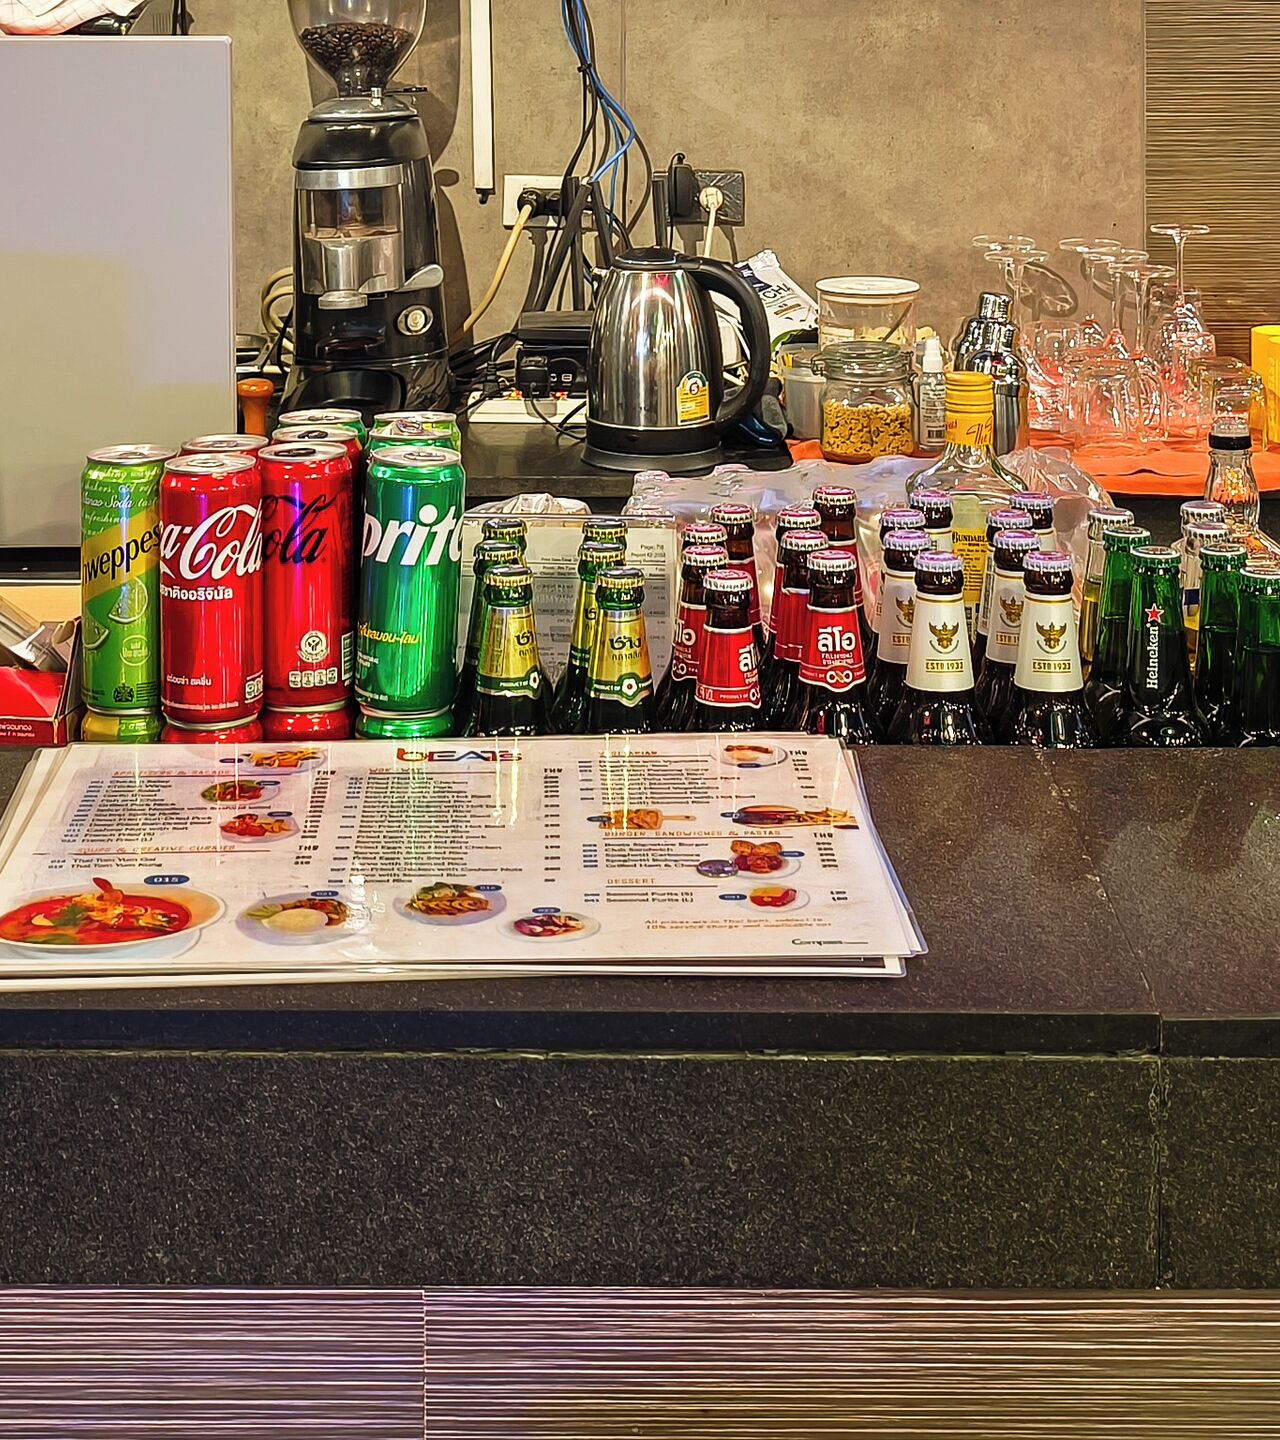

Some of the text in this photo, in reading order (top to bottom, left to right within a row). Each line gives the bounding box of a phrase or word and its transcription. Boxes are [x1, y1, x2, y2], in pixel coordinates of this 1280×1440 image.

[105, 495, 134, 508] Soda
[818, 626, 856, 652] ลีโอ
[1146, 625, 1159, 690] Heineken
